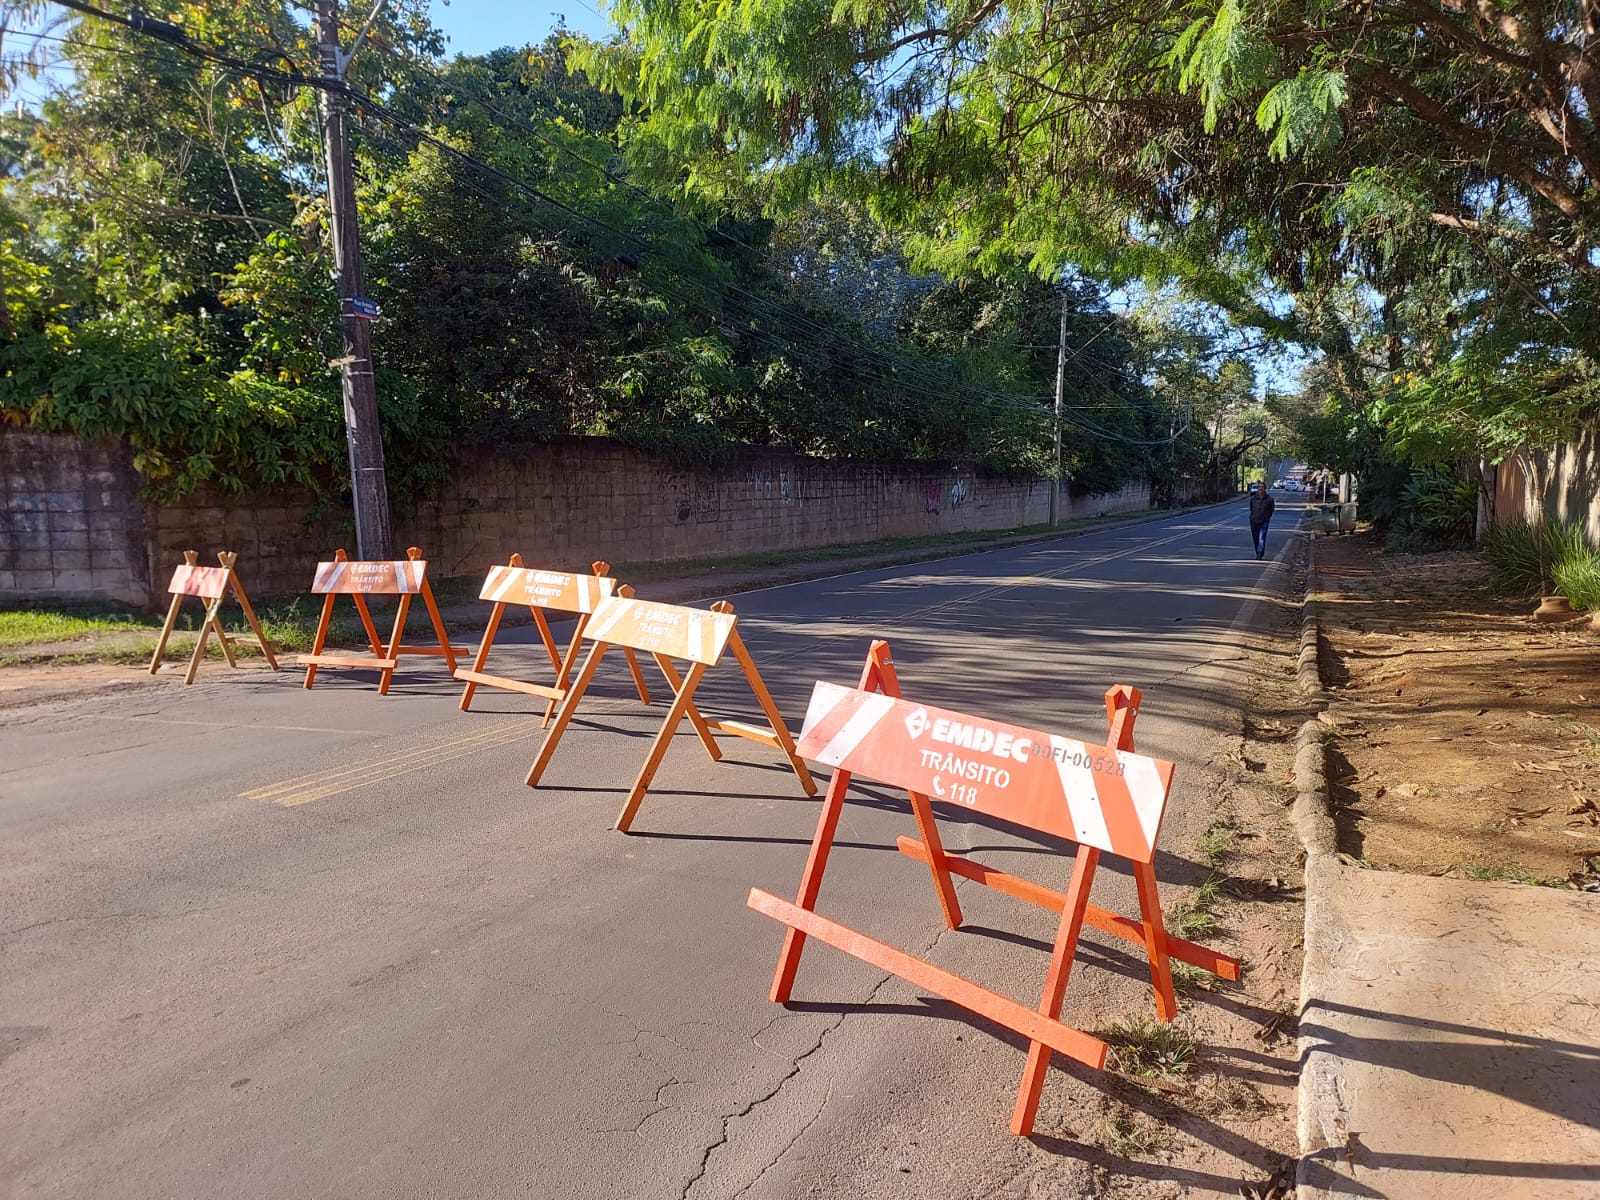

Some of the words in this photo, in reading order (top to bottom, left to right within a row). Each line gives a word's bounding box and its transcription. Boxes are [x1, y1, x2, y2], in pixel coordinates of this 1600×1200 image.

[359, 564, 389, 573] EMDEC
[931, 718, 1032, 763] EMDEC
[920, 749, 1010, 789] TRÂNSITO
[950, 782, 978, 805] 118
